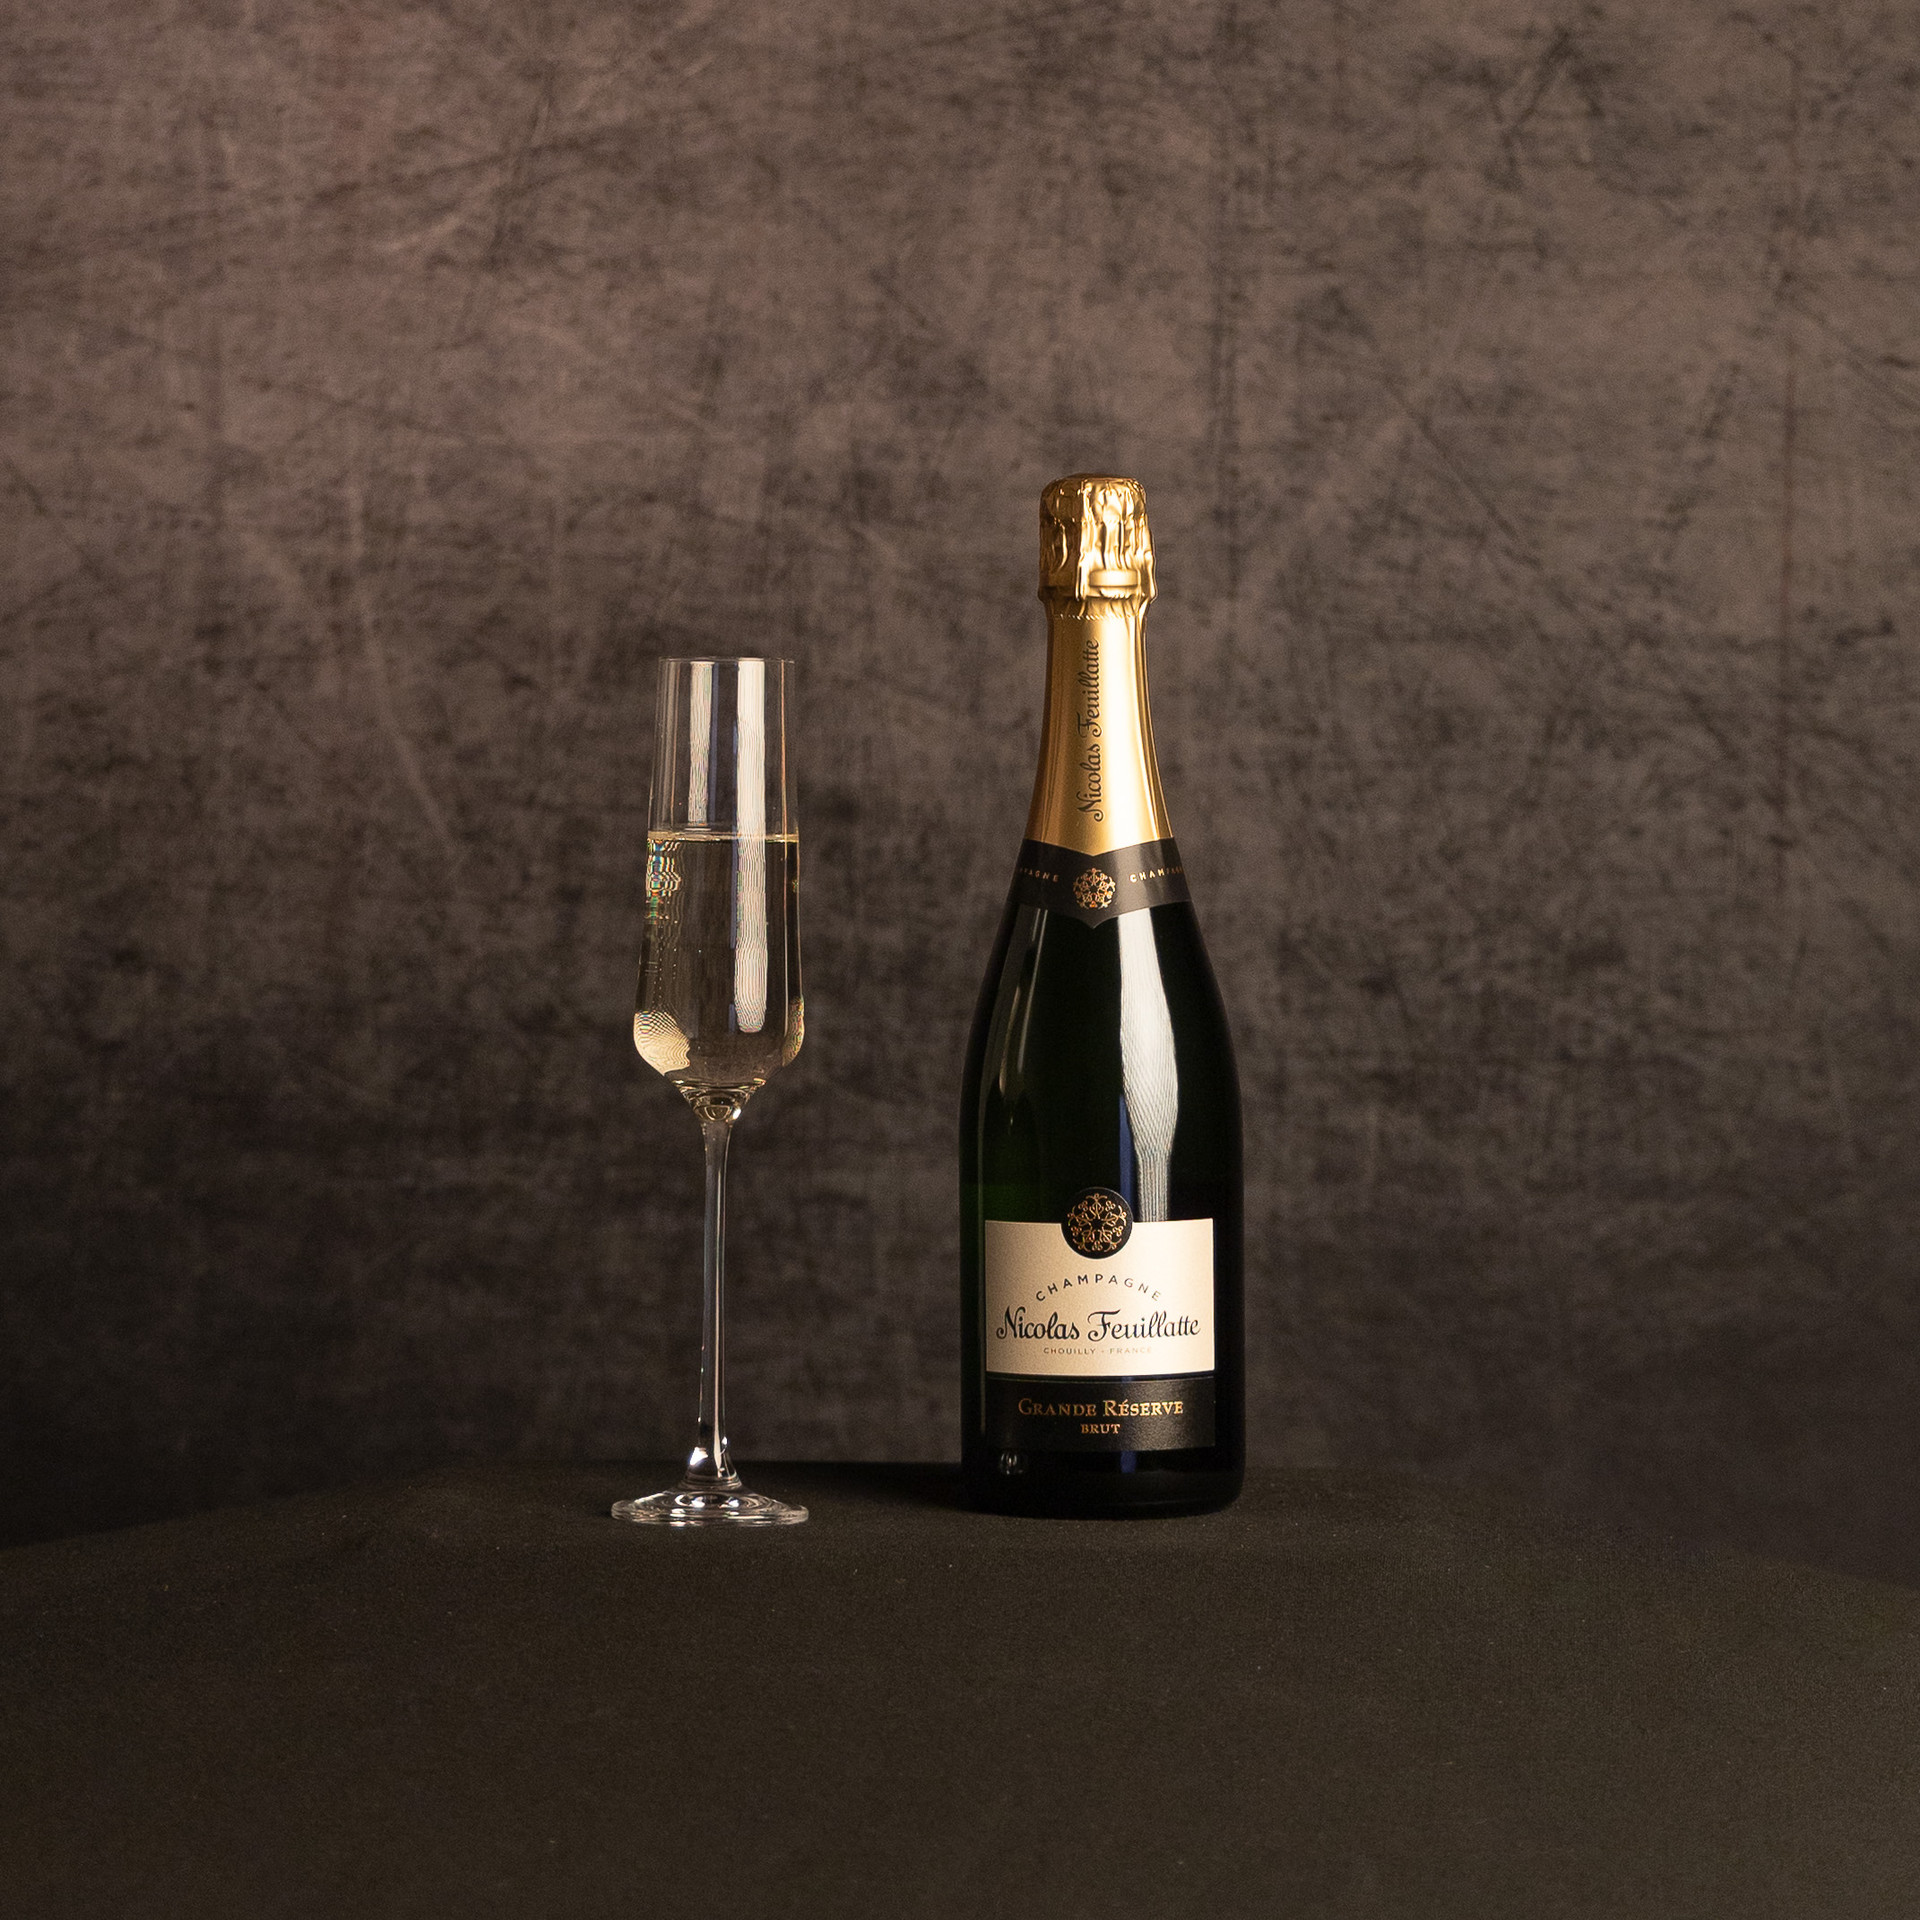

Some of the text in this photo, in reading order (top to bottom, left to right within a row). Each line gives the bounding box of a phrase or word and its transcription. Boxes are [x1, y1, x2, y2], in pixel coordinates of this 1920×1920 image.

[1076, 637, 1104, 822] Nicolas Feuillatte
[1036, 1273, 1162, 1302] CHAMPAGNE
[996, 1305, 1201, 1342] Nicolas Feuillatte
[1043, 1347, 1096, 1355] CHOUILLY
[1109, 1346, 1152, 1355] FRANCE
[1017, 1397, 1097, 1417] GRANDE
[1080, 1423, 1121, 1434] BRUT
